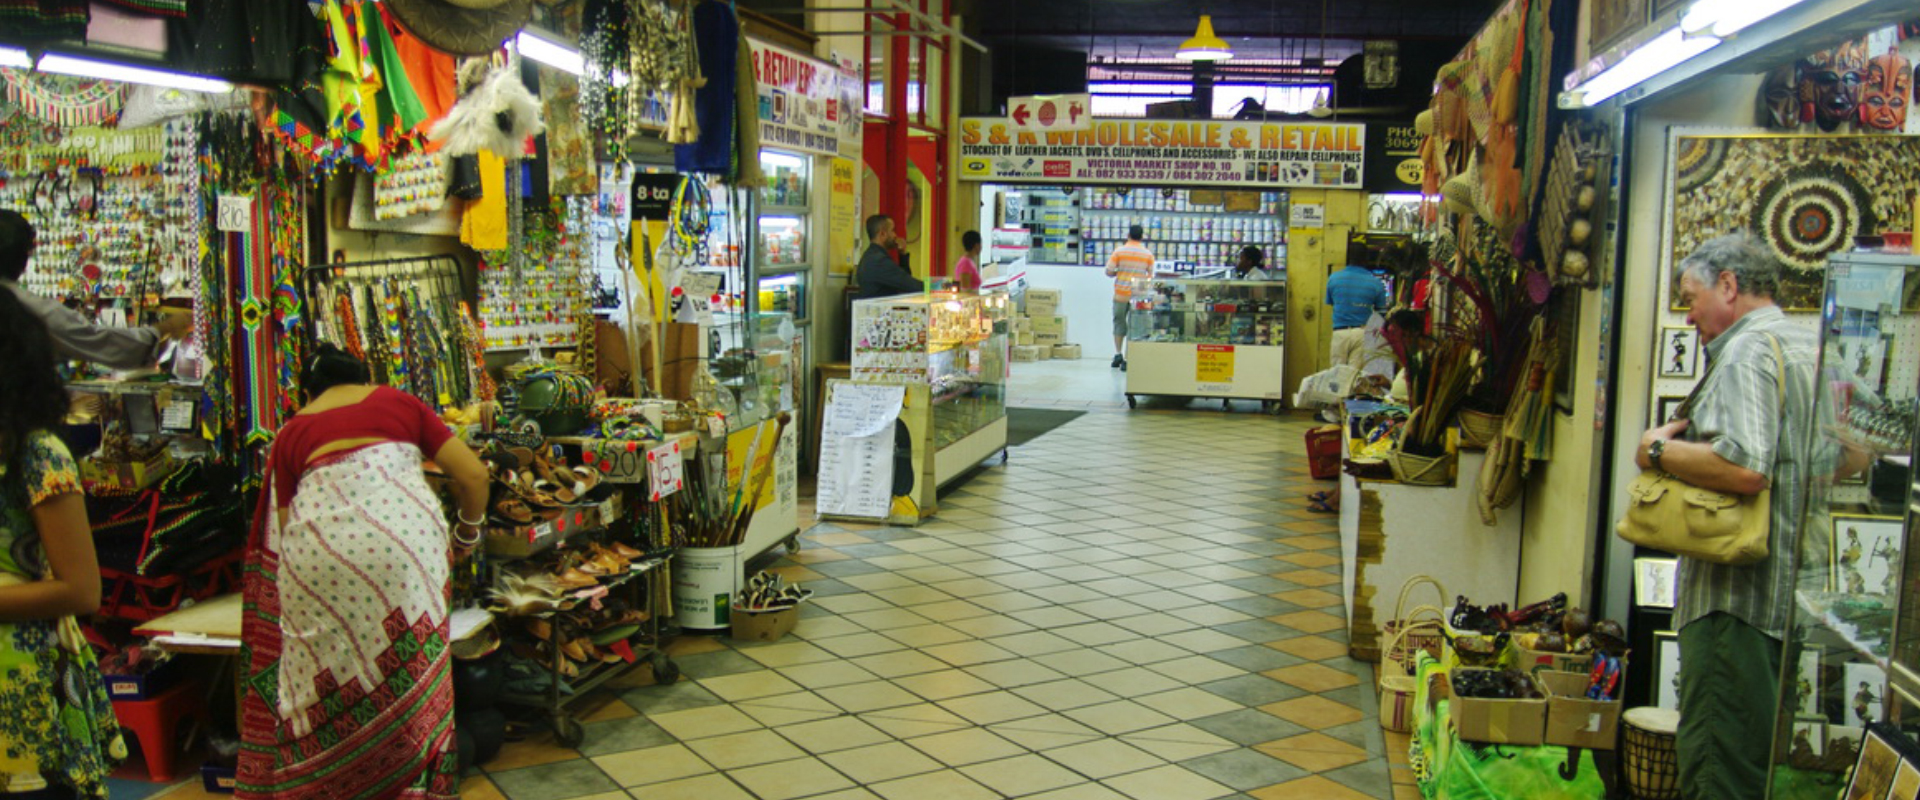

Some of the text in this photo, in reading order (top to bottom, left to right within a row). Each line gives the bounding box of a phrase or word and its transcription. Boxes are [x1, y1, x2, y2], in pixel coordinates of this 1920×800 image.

[962, 120, 981, 144] S
[988, 124, 1009, 144] &
[1046, 122, 1221, 147] WHOLESALE
[1229, 127, 1251, 149] &
[1260, 124, 1361, 151] RETAIL
[962, 145, 999, 156] STOCKIST
[1002, 145, 1011, 156] OF
[1015, 146, 1047, 156] LEATHER
[1112, 147, 1161, 158] CELLPHONES
[1163, 148, 1179, 158] AND
[1181, 149, 1236, 159] ACCESSORIES
[1243, 150, 1256, 160] WE
[1258, 151, 1278, 161] ALSO
[1280, 151, 1308, 161] REPAIR
[1311, 152, 1361, 162] CELLPHONES
[1087, 159, 1232, 170] VICTORIA MARKET SHOP NO. 10
[997, 169, 1042, 177] vodacom
[1096, 169, 1114, 179] 082
[1116, 170, 1135, 179] 933
[1137, 170, 1164, 180] 3339
[1173, 171, 1192, 180] 084
[1194, 171, 1214, 181] 302
[1216, 172, 1241, 182] 2040
[1409, 171, 1420, 183] 9
